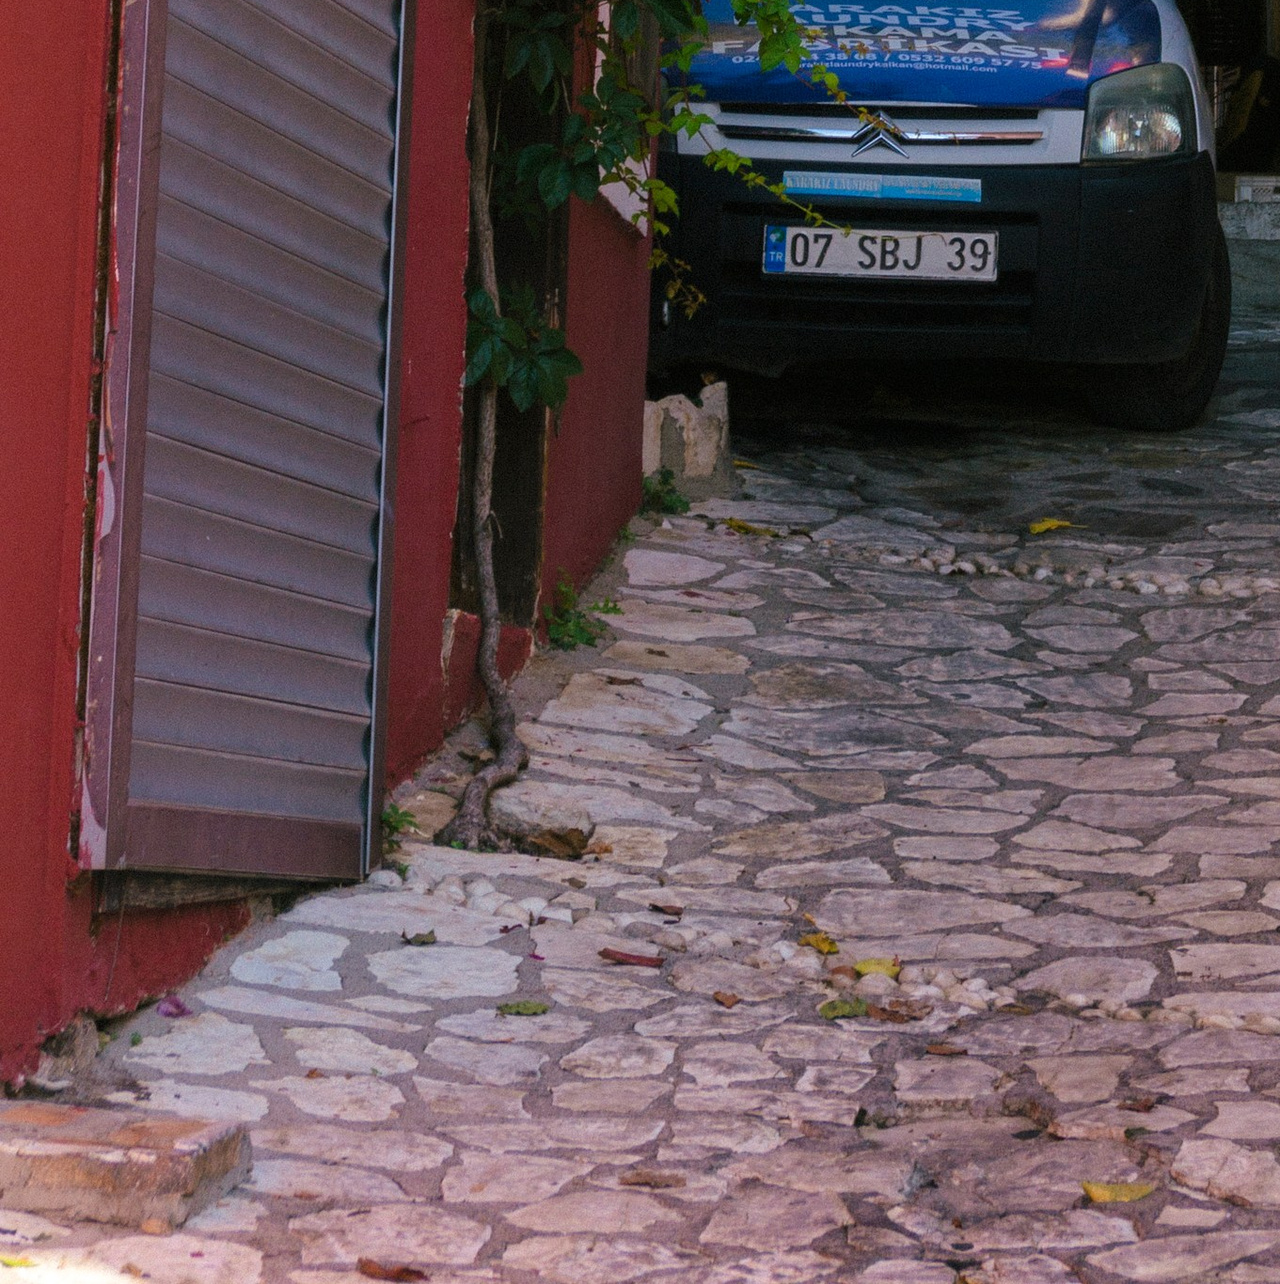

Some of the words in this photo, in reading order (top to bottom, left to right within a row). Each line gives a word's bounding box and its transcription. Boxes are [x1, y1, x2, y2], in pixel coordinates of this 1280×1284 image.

[788, 3, 1024, 20] ARAKIZ
[826, 52, 848, 61] 38
[854, 52, 877, 61] 68
[898, 53, 945, 63] 0532
[951, 55, 985, 65] 609
[991, 58, 1012, 67] 57
[1018, 60, 1042, 70] 75
[769, 251, 783, 262] TR
[790, 233, 833, 268] 07
[858, 235, 923, 271] SBJ
[947, 237, 990, 272] 39
